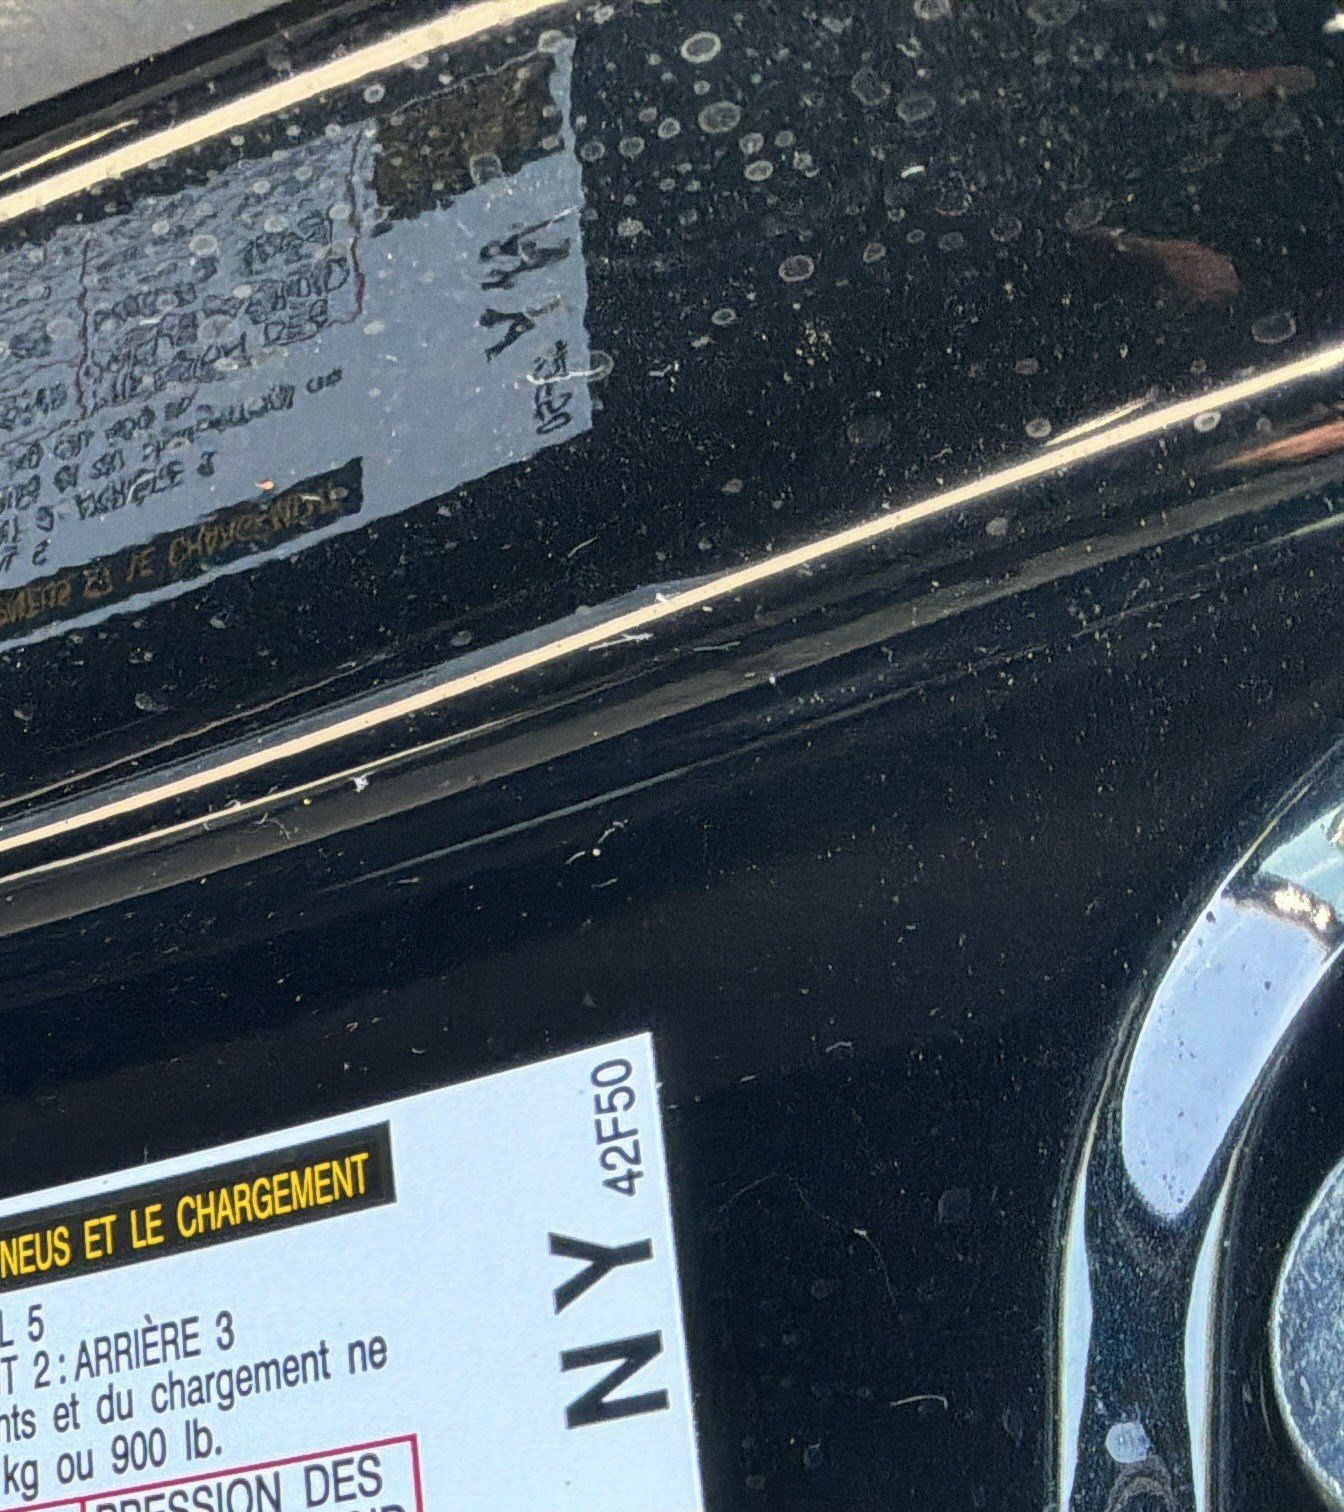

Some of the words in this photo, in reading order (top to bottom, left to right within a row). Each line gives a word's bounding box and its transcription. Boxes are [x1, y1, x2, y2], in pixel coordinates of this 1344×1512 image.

[590, 1058, 644, 1197] 42F50
[83, 1213, 116, 1259] ET
[129, 1203, 164, 1248] LE
[176, 1151, 369, 1237] CHARGEMENT
[548, 1232, 653, 1313] Y
[27, 1303, 44, 1342] 5
[74, 1315, 201, 1381] ARRIÈRE
[215, 1309, 235, 1351] 3
[52, 1392, 80, 1433] et
[96, 1382, 133, 1425] du
[150, 1339, 331, 1414] chargement
[347, 1335, 387, 1374] ne
[560, 1330, 669, 1429] N
[3, 1454, 39, 1499] kg
[56, 1448, 94, 1485] ou
[110, 1426, 167, 1475] 900
[184, 1417, 222, 1461] lb.
[303, 1451, 382, 1508] DES
